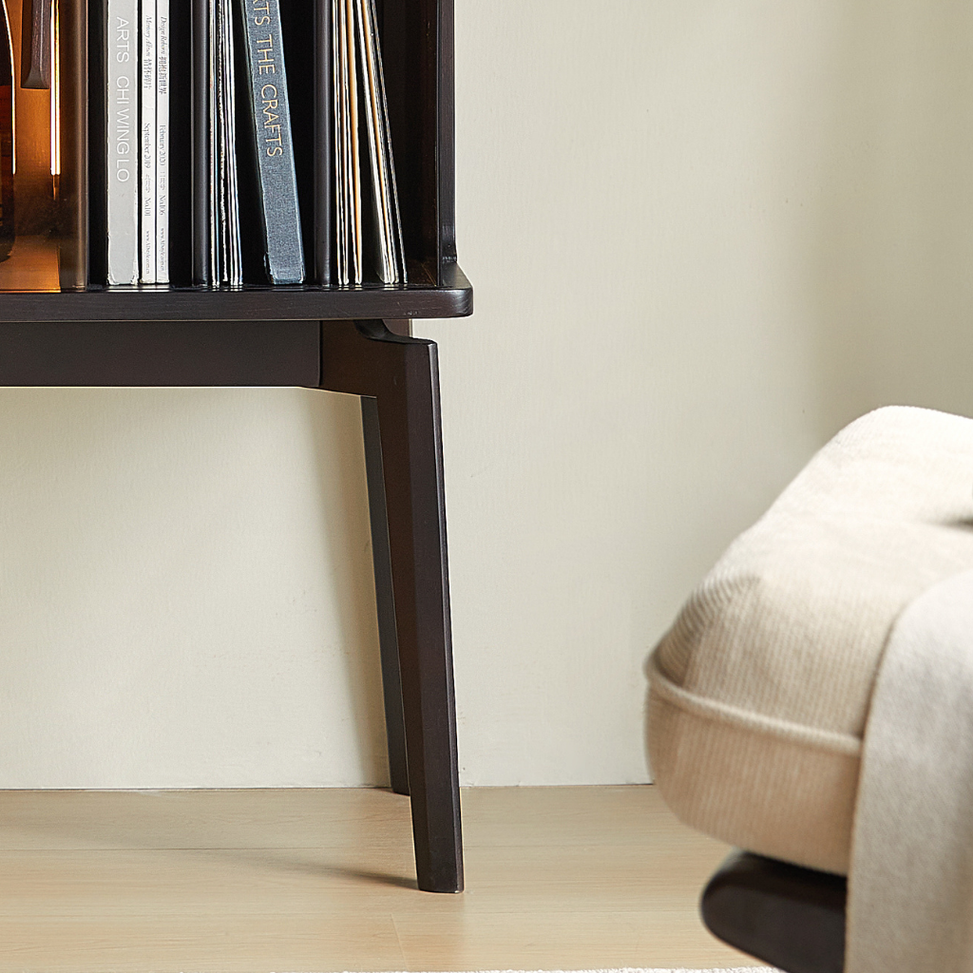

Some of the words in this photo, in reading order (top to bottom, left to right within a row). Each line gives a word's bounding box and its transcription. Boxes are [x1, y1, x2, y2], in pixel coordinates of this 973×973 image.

[116, 16, 130, 63] ARTS
[256, 33, 275, 75] THE
[116, 75, 130, 104] CHI
[116, 108, 130, 155] WING
[260, 83, 283, 157] CRAFTS
[116, 159, 130, 182] LO
